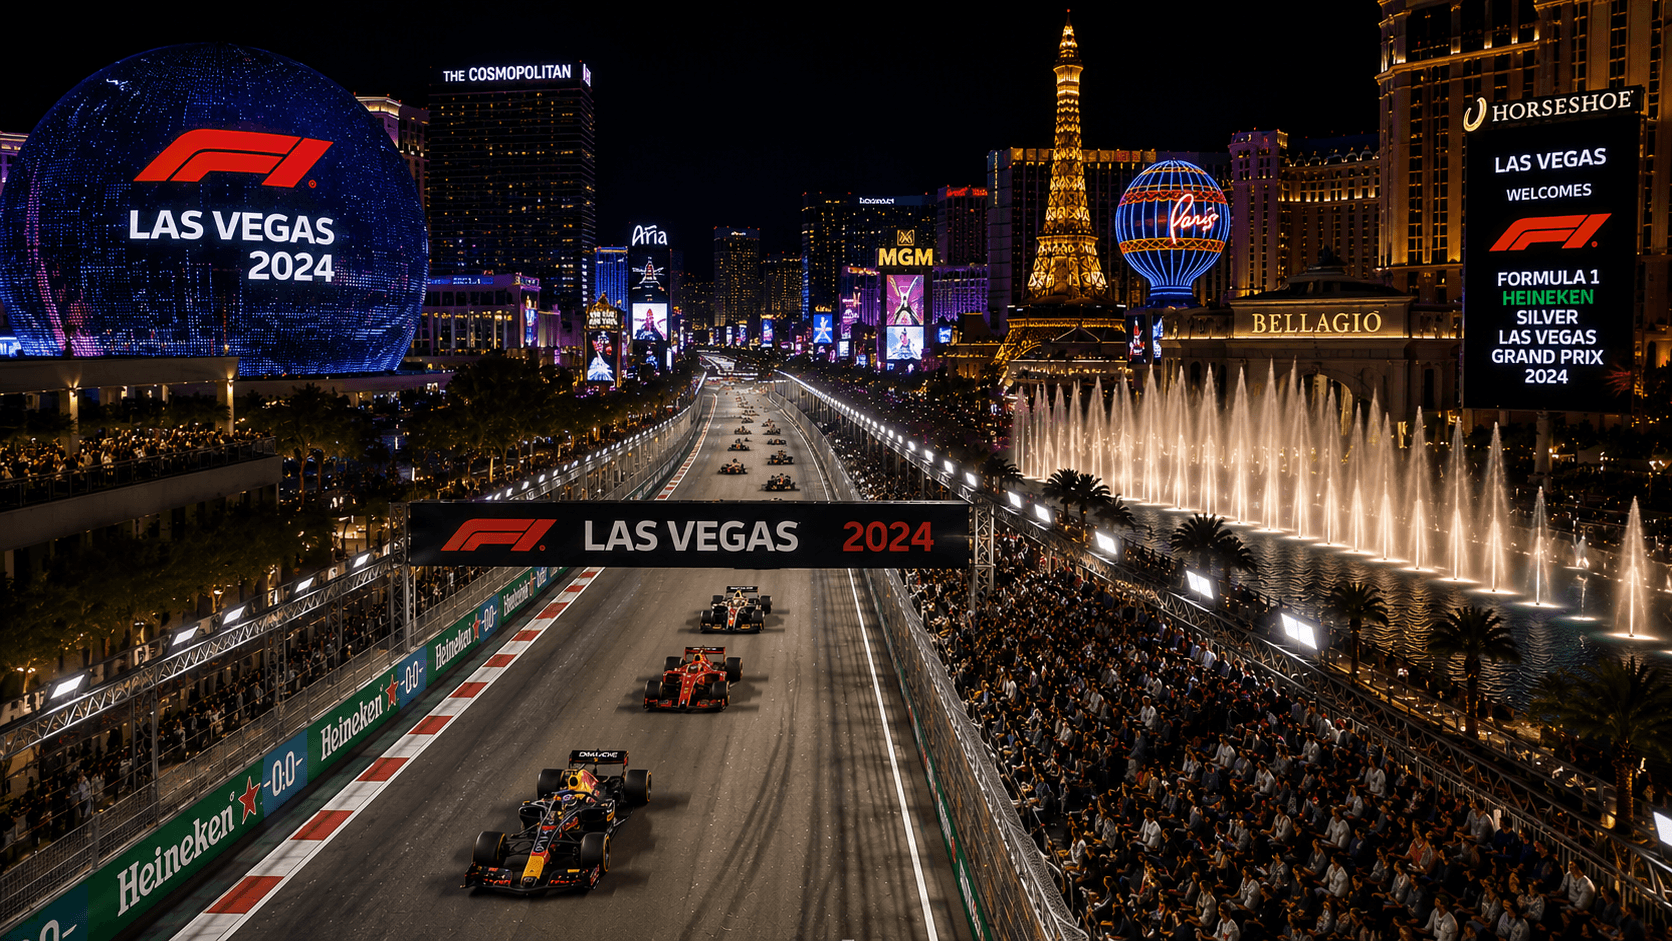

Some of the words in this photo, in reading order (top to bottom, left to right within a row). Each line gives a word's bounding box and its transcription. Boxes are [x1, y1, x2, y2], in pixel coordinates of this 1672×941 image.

[443, 70, 466, 82] THE
[468, 64, 572, 82] COSMOPOLITAN
[1492, 90, 1633, 122] HORSESHOE
[1495, 154, 1532, 174] LAS
[1536, 147, 1607, 170] VEGAS
[1506, 183, 1592, 202] WELCOMES
[129, 209, 204, 241] LAS
[212, 210, 335, 247] VEGAS
[1170, 193, 1220, 245] Paris
[247, 250, 336, 284] 2024
[878, 247, 934, 267] MGM
[1497, 270, 1587, 287] FORMULA
[1590, 269, 1600, 285] 1
[1502, 289, 1594, 306] HEINEKEN
[1251, 311, 1383, 335] BELLAGIO
[1516, 309, 1579, 325] SILVER
[1499, 329, 1532, 345] LAS
[1534, 329, 1597, 345] VEGAS
[1491, 348, 1556, 364] GRAND
[1560, 349, 1604, 365] PRIX
[1524, 368, 1569, 385] 2024
[584, 520, 658, 552] LAS
[666, 520, 799, 552] VEGAS
[842, 520, 935, 552] 2024
[320, 694, 383, 761] Heineken
[117, 804, 235, 917] Heineken
